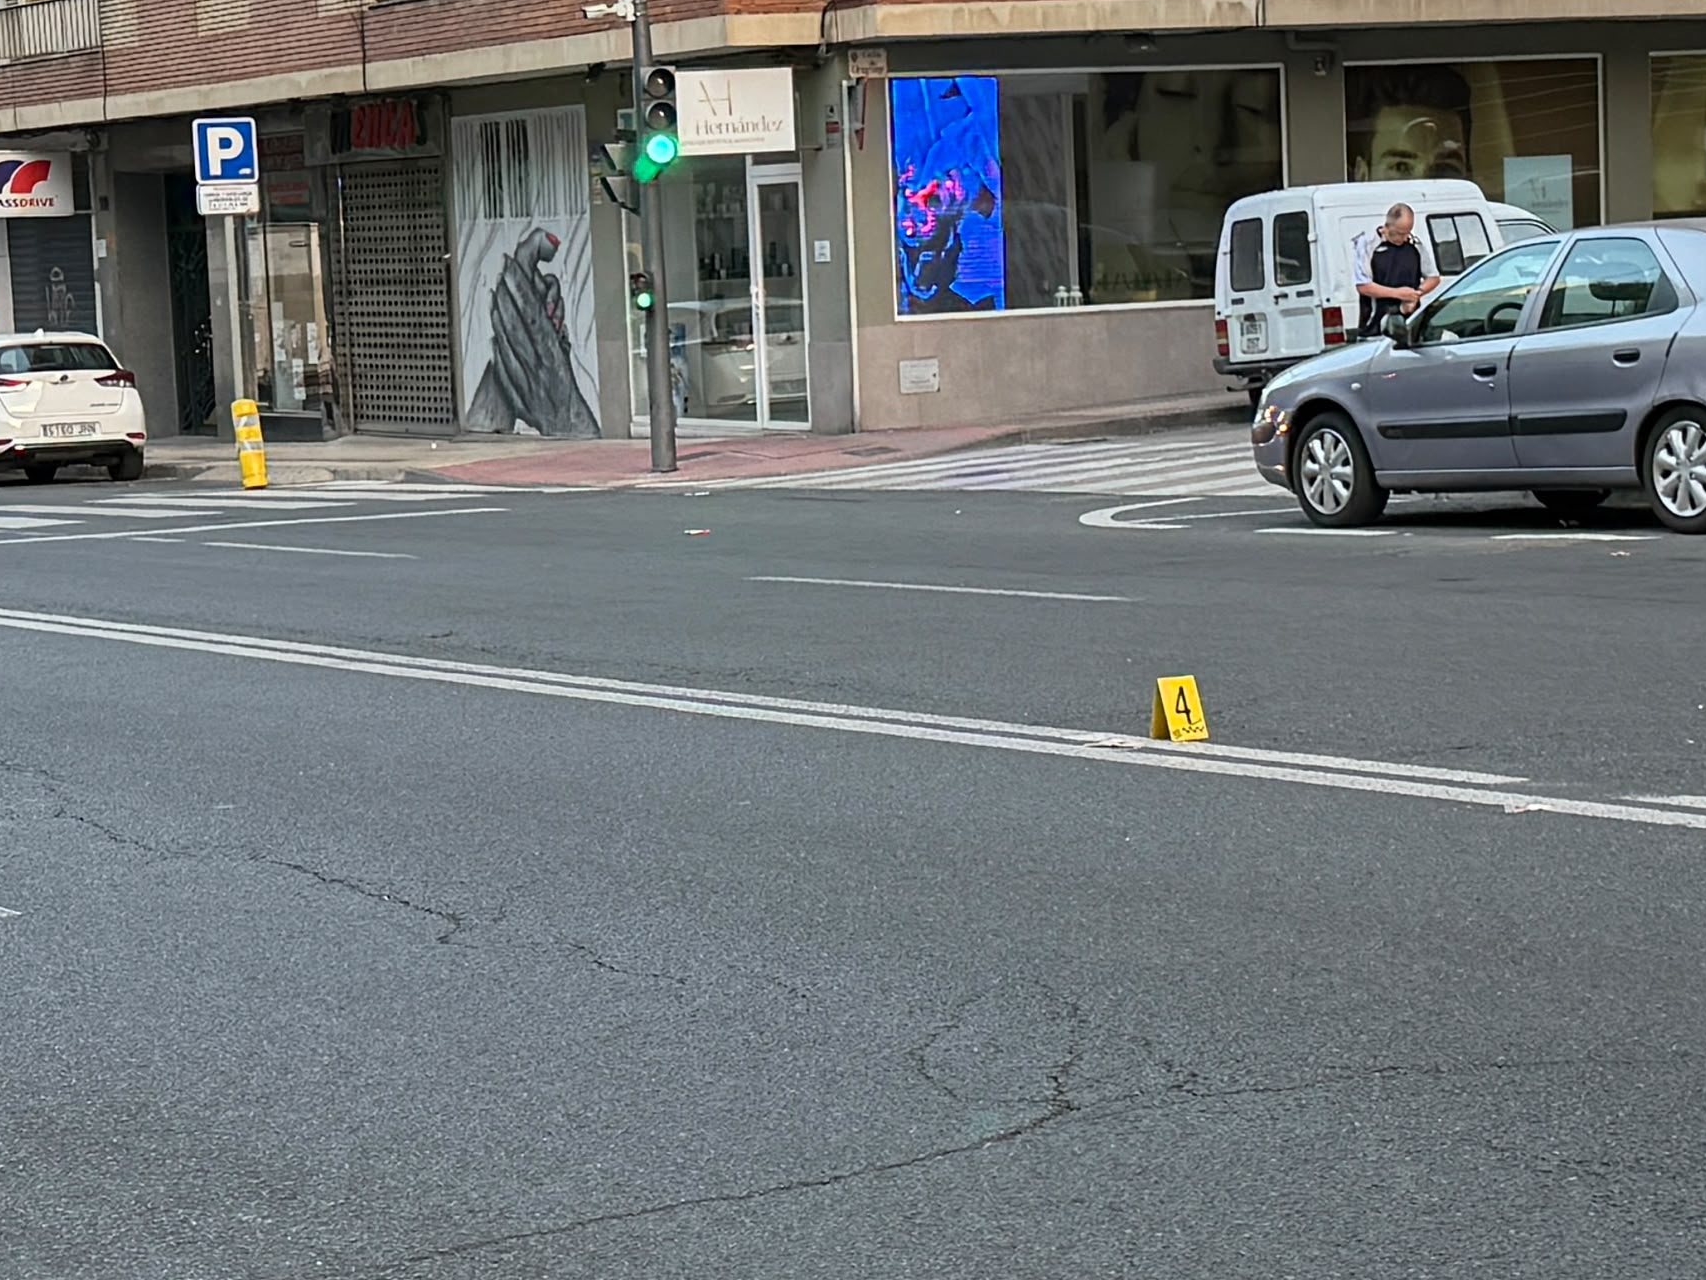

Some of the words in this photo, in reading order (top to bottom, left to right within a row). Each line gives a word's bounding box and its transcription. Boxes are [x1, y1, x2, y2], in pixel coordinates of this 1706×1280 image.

[695, 115, 783, 135] Hernández
[207, 127, 244, 176] P
[1176, 686, 1191, 725] 4
